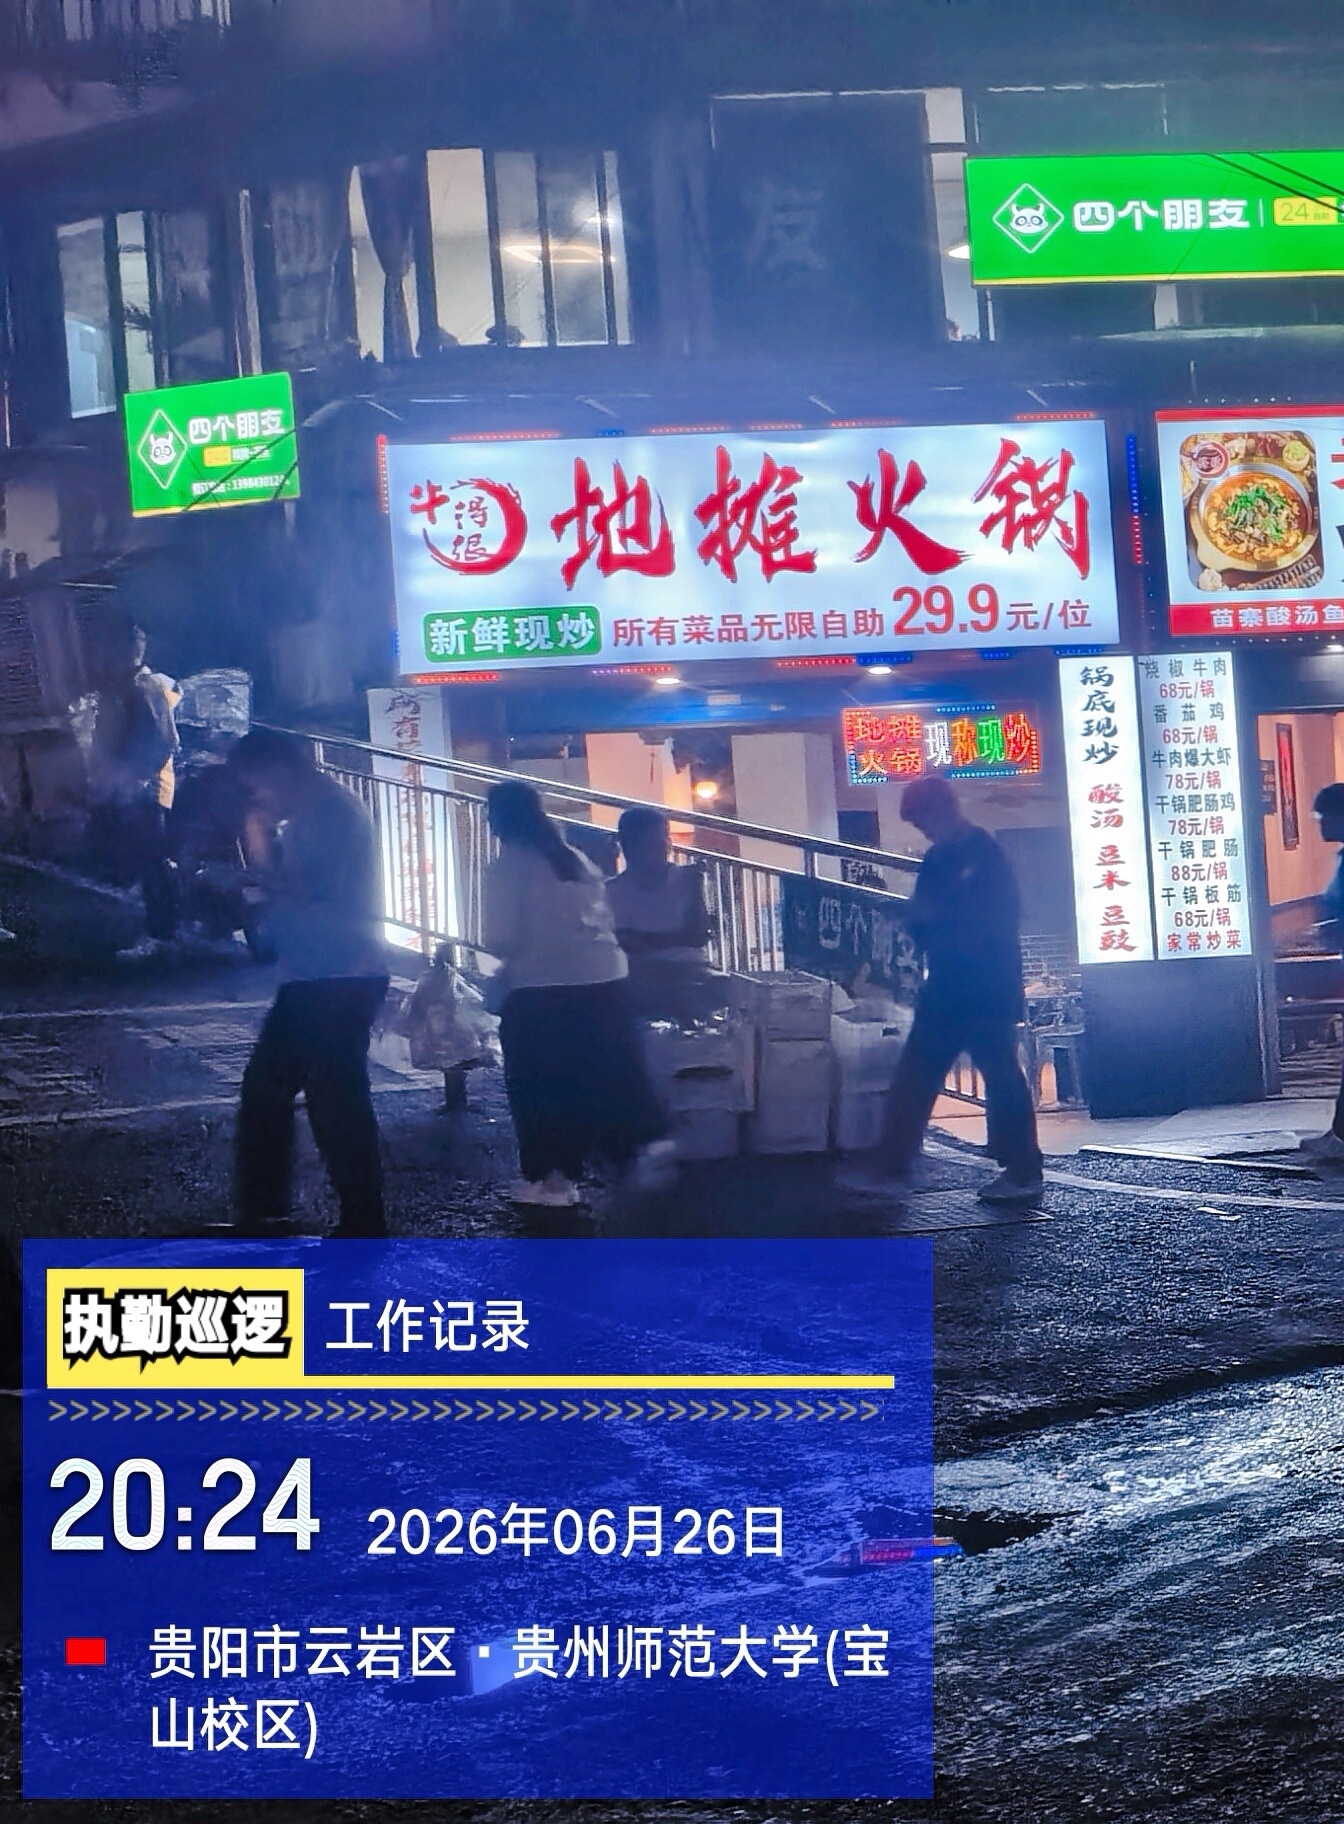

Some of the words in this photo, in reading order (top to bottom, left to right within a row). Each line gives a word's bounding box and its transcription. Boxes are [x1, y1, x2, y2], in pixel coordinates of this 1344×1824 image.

[1073, 198, 1250, 233] 四个朋友
[189, 409, 285, 444] 四个朋友
[551, 437, 1090, 591] 地摊火锅
[429, 612, 596, 655] 新鲜现炒
[1145, 657, 1227, 679] 烧椒牛肉
[1160, 680, 1215, 699] 68元/锅
[1078, 666, 1120, 765] 锅底现炒
[1153, 702, 1225, 723] 番茄鸡
[853, 714, 922, 744] 地摊
[1163, 725, 1218, 745] 68元/锅
[858, 747, 924, 775] 火锅
[1151, 747, 1232, 769] 牛肉爆大虾
[1165, 770, 1221, 790] 78元/锅
[1088, 783, 1125, 829] 酸汤
[1155, 792, 1236, 814] 干锅肥肠鸡
[1168, 816, 1224, 836] 78元/锅
[1157, 838, 1239, 860] 干锅肥肠
[1093, 844, 1132, 891] 豆米
[1171, 861, 1228, 881] 88元/锅
[1161, 883, 1242, 907] 干锅板筋
[1174, 907, 1231, 928] 68元/锅
[1167, 929, 1242, 952] 家常炒菜
